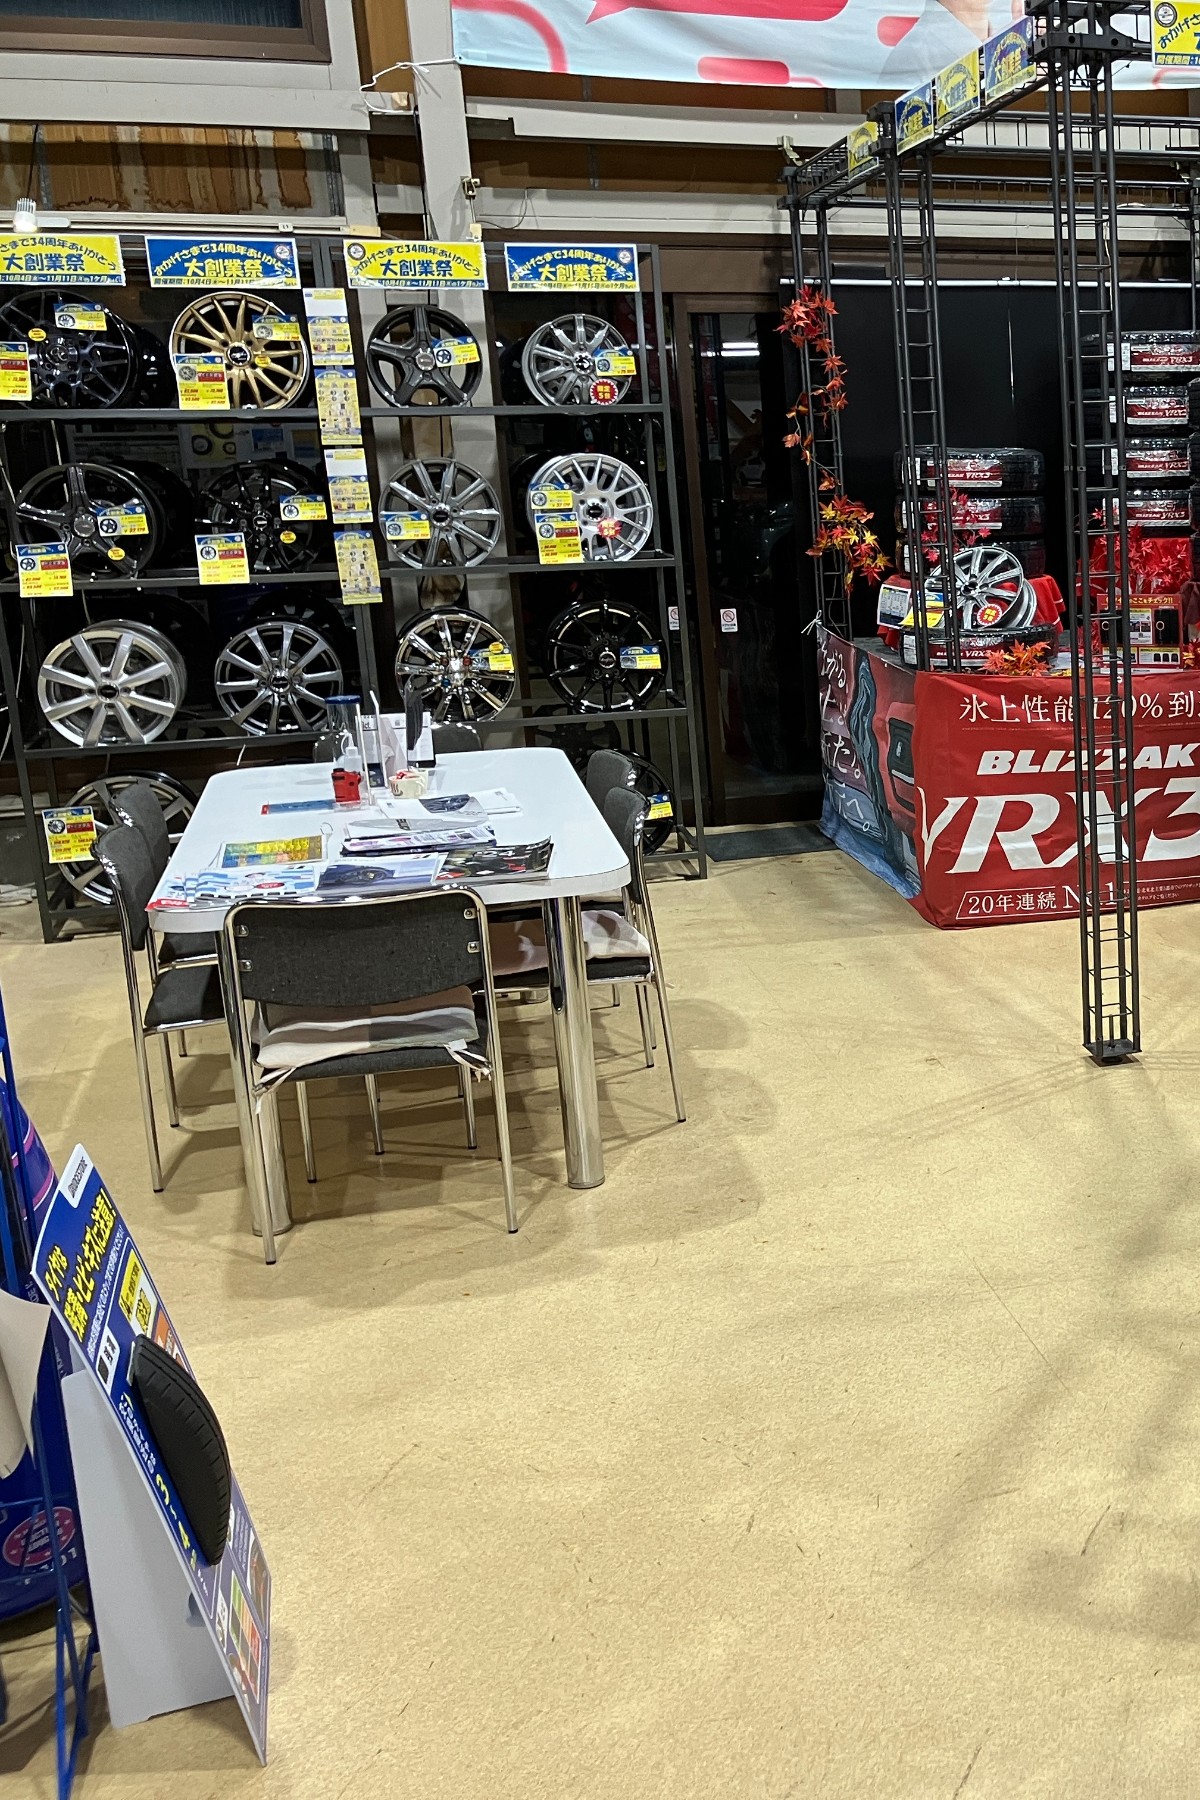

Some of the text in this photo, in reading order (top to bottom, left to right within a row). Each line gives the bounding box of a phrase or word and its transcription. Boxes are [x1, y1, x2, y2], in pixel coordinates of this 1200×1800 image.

[3, 253, 87, 273] 大創業祭
[154, 242, 293, 278] おかげさまで34周年ありがとう
[184, 259, 264, 278] 大創業祭
[352, 244, 481, 276] おかげさまで34周年ありがとう
[380, 259, 454, 277] 大創業祭
[538, 263, 608, 282] 大創業祭
[959, 693, 1073, 724] 氷上性能
[968, 892, 1058, 916] 20年連続
